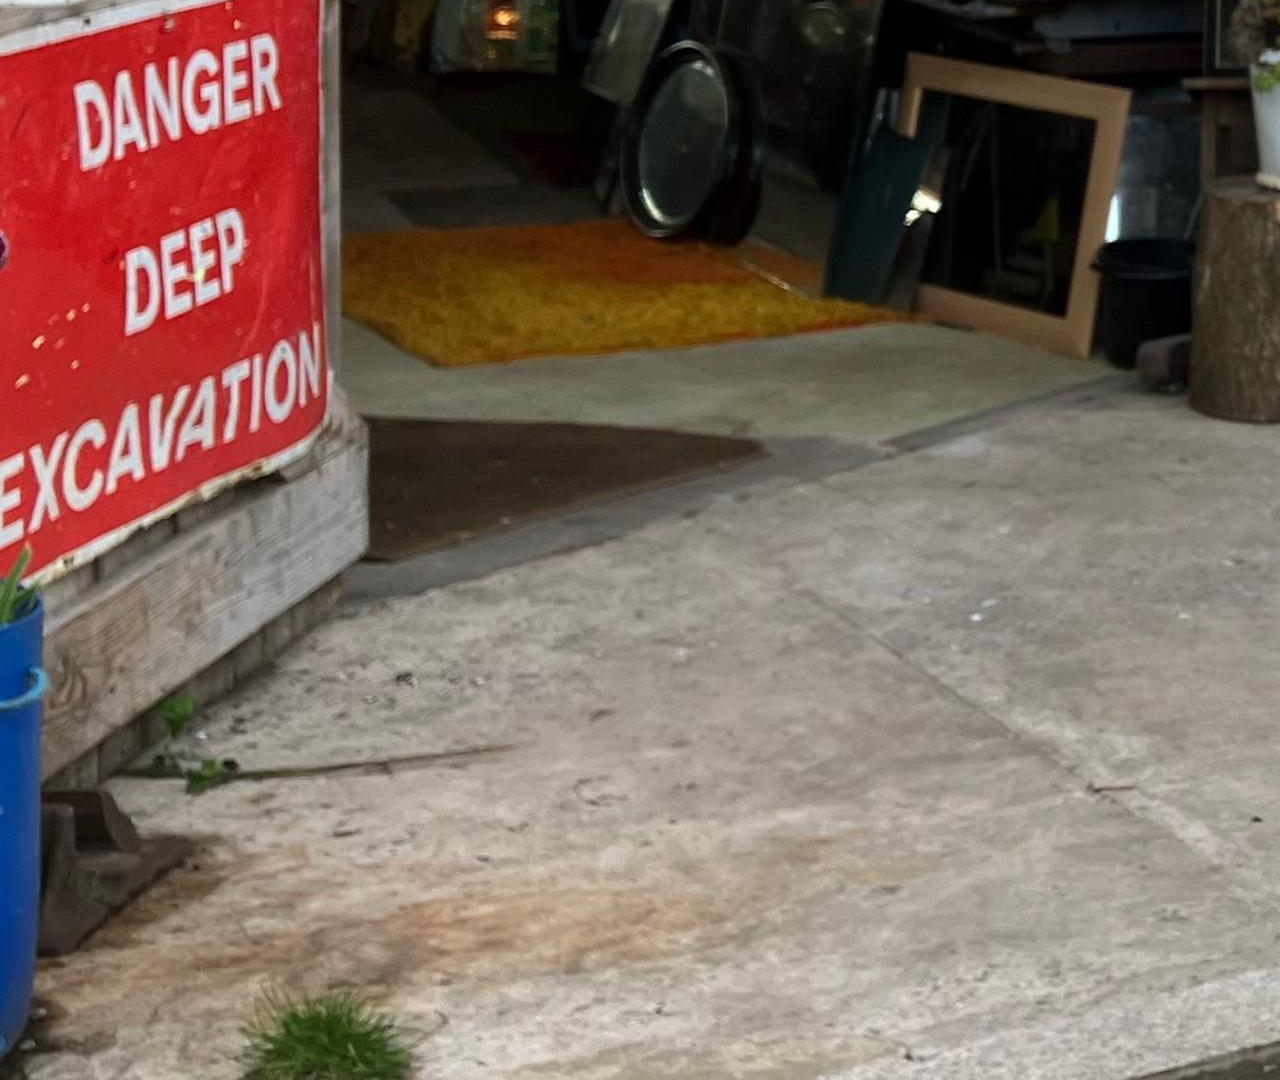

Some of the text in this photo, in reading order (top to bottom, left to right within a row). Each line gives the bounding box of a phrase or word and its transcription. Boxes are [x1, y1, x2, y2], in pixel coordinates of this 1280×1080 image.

[73, 32, 283, 172] DANGER
[123, 207, 248, 338] DEEP
[0, 322, 322, 545] EXCAVATION
